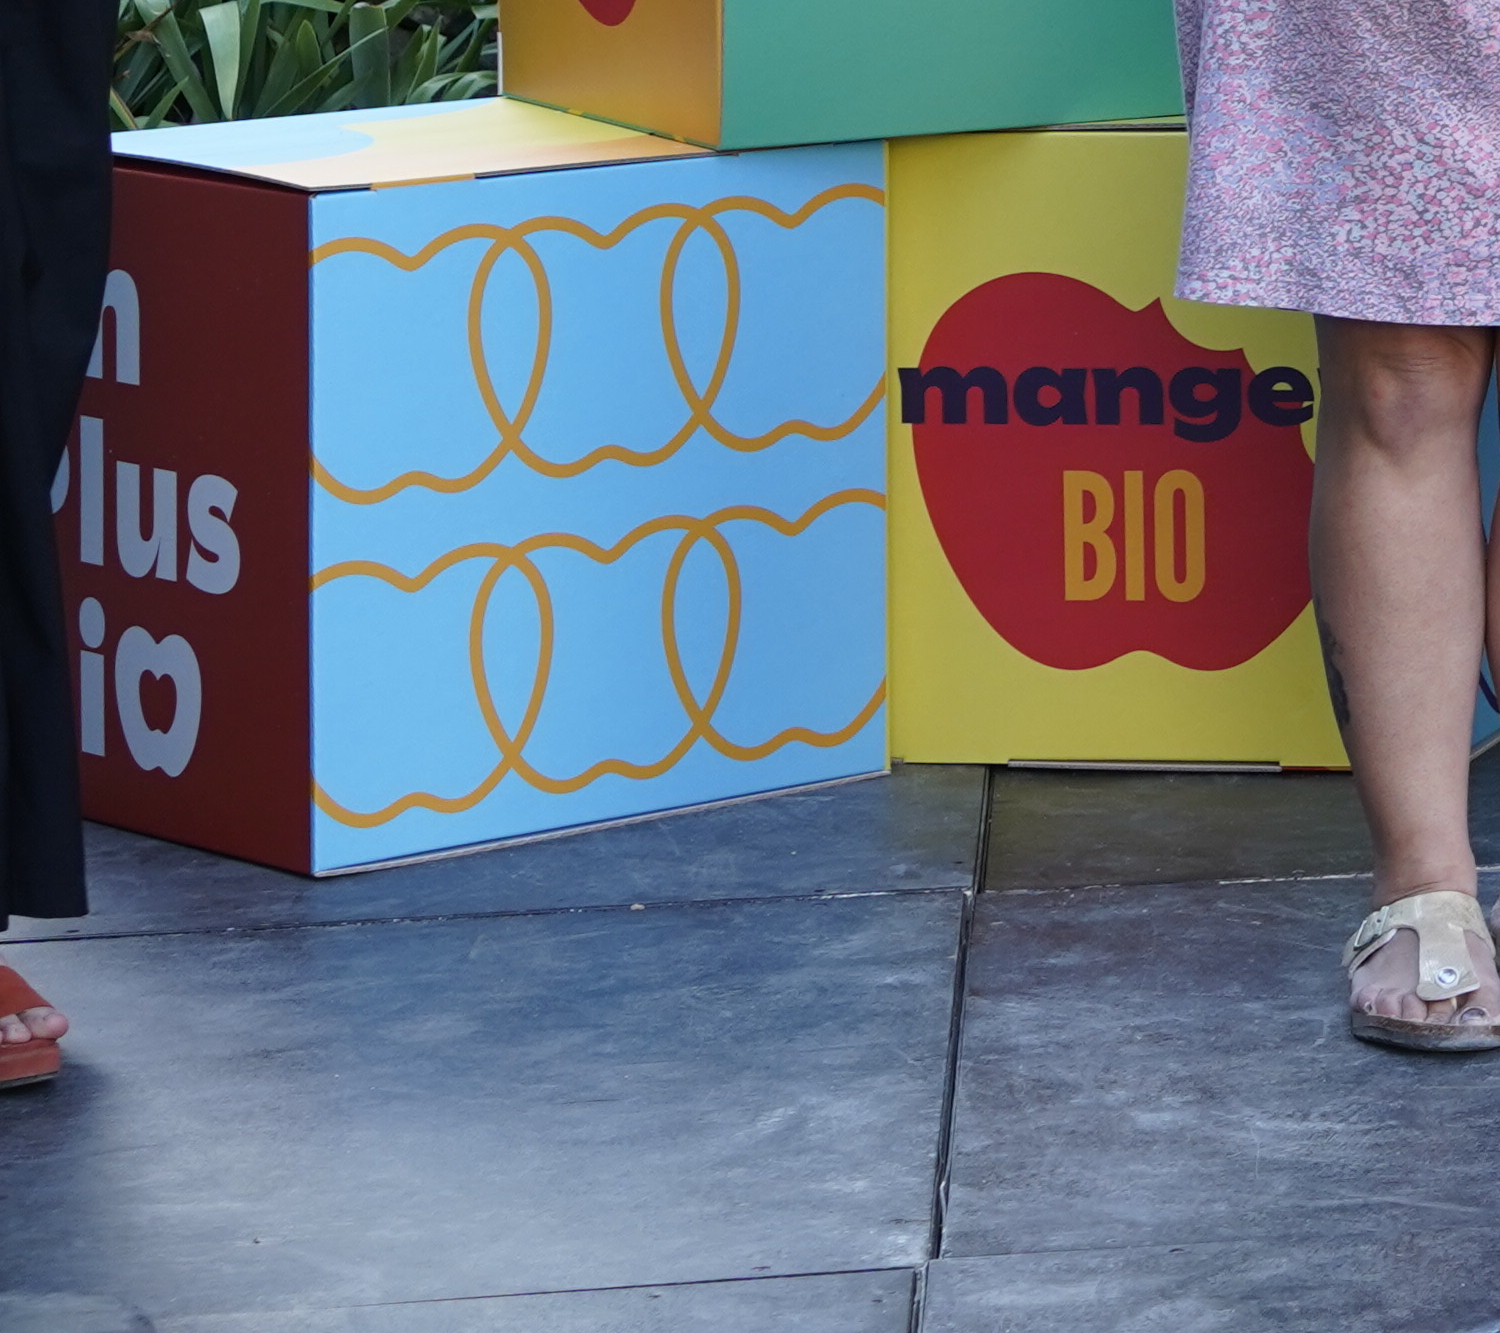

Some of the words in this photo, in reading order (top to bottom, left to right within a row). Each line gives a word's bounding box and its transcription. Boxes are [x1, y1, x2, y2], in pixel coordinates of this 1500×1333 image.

[86, 268, 141, 387] n
[898, 365, 1322, 444] mange
[50, 414, 241, 595] lus
[1063, 469, 1206, 603] BIO
[79, 595, 202, 778] io
